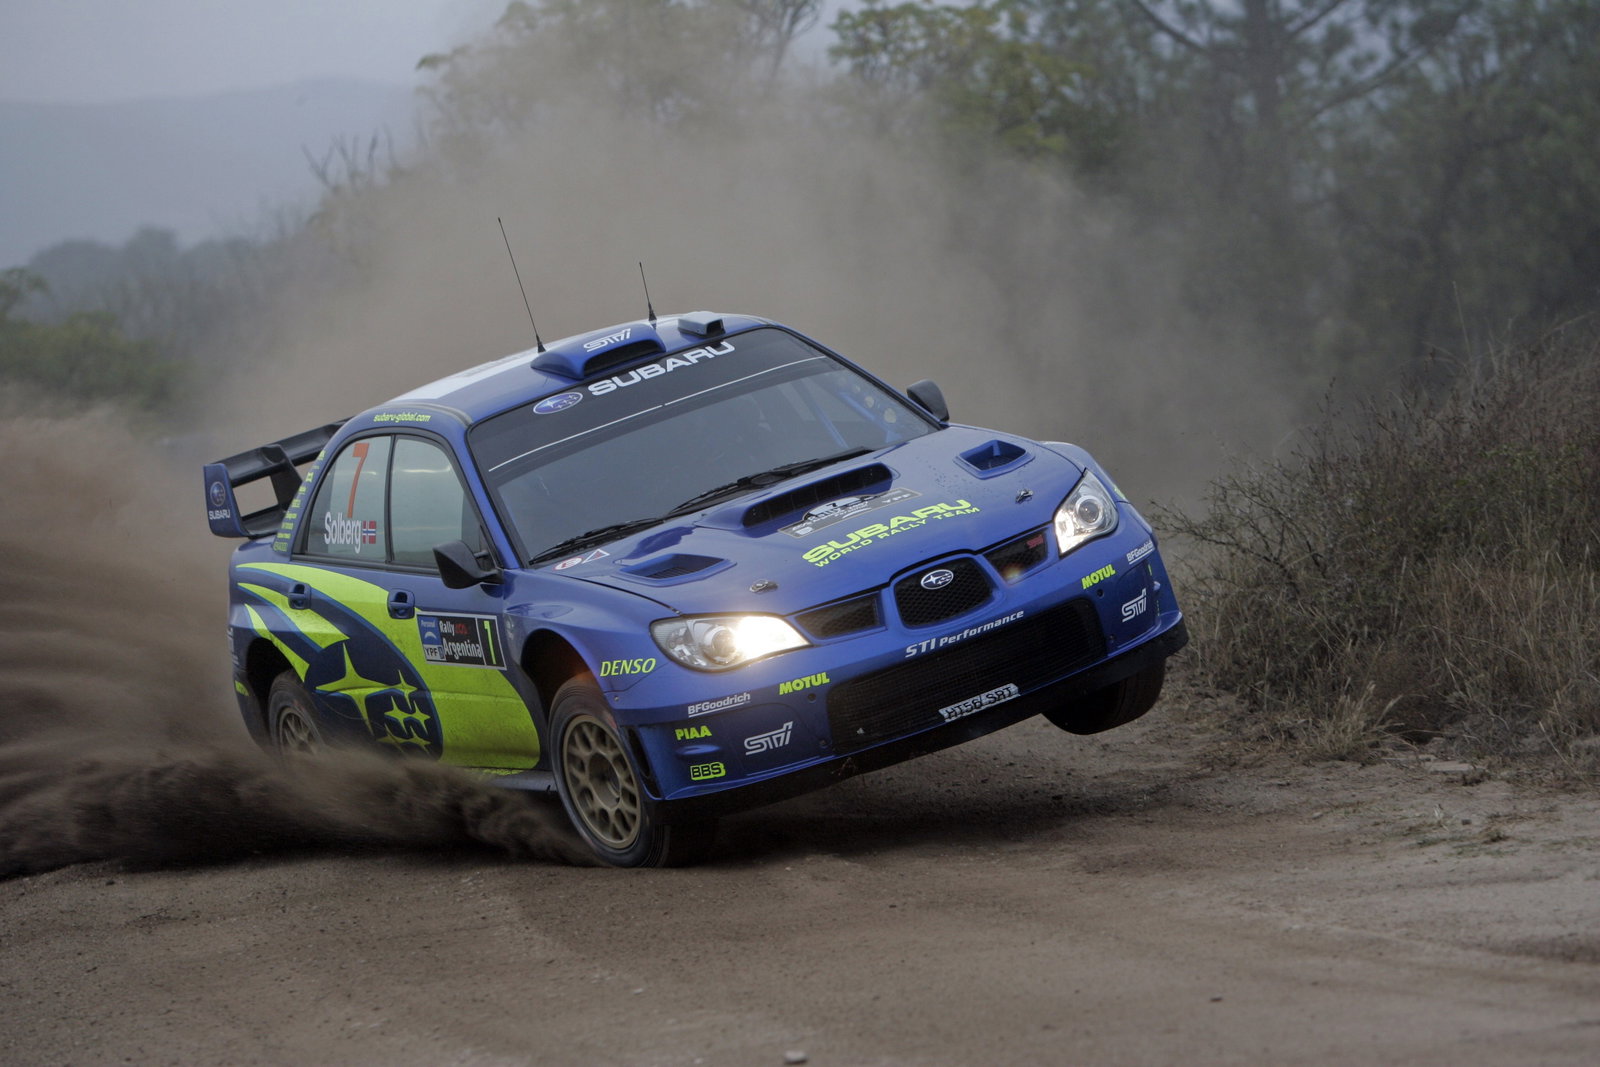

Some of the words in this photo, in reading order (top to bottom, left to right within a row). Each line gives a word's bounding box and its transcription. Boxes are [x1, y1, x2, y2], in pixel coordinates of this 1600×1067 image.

[587, 341, 736, 396] SUBARU
[346, 443, 370, 518] 7
[208, 509, 231, 520] SUBARU
[324, 511, 362, 554] Solberg
[801, 499, 974, 563] SUBARU
[814, 538, 873, 568] WORLD
[878, 519, 927, 539] RALLY
[933, 506, 981, 522] TEAM
[1081, 563, 1116, 590] MOTUL
[439, 620, 455, 637] Rally
[905, 638, 936, 658] STI
[939, 610, 1025, 647] Performance
[442, 637, 483, 660] Argentina
[599, 657, 656, 677] DENSO
[779, 672, 830, 695] MOTUL
[687, 692, 751, 716] BFGoodrich
[675, 725, 712, 741] PIAA
[691, 762, 722, 779] BBS
